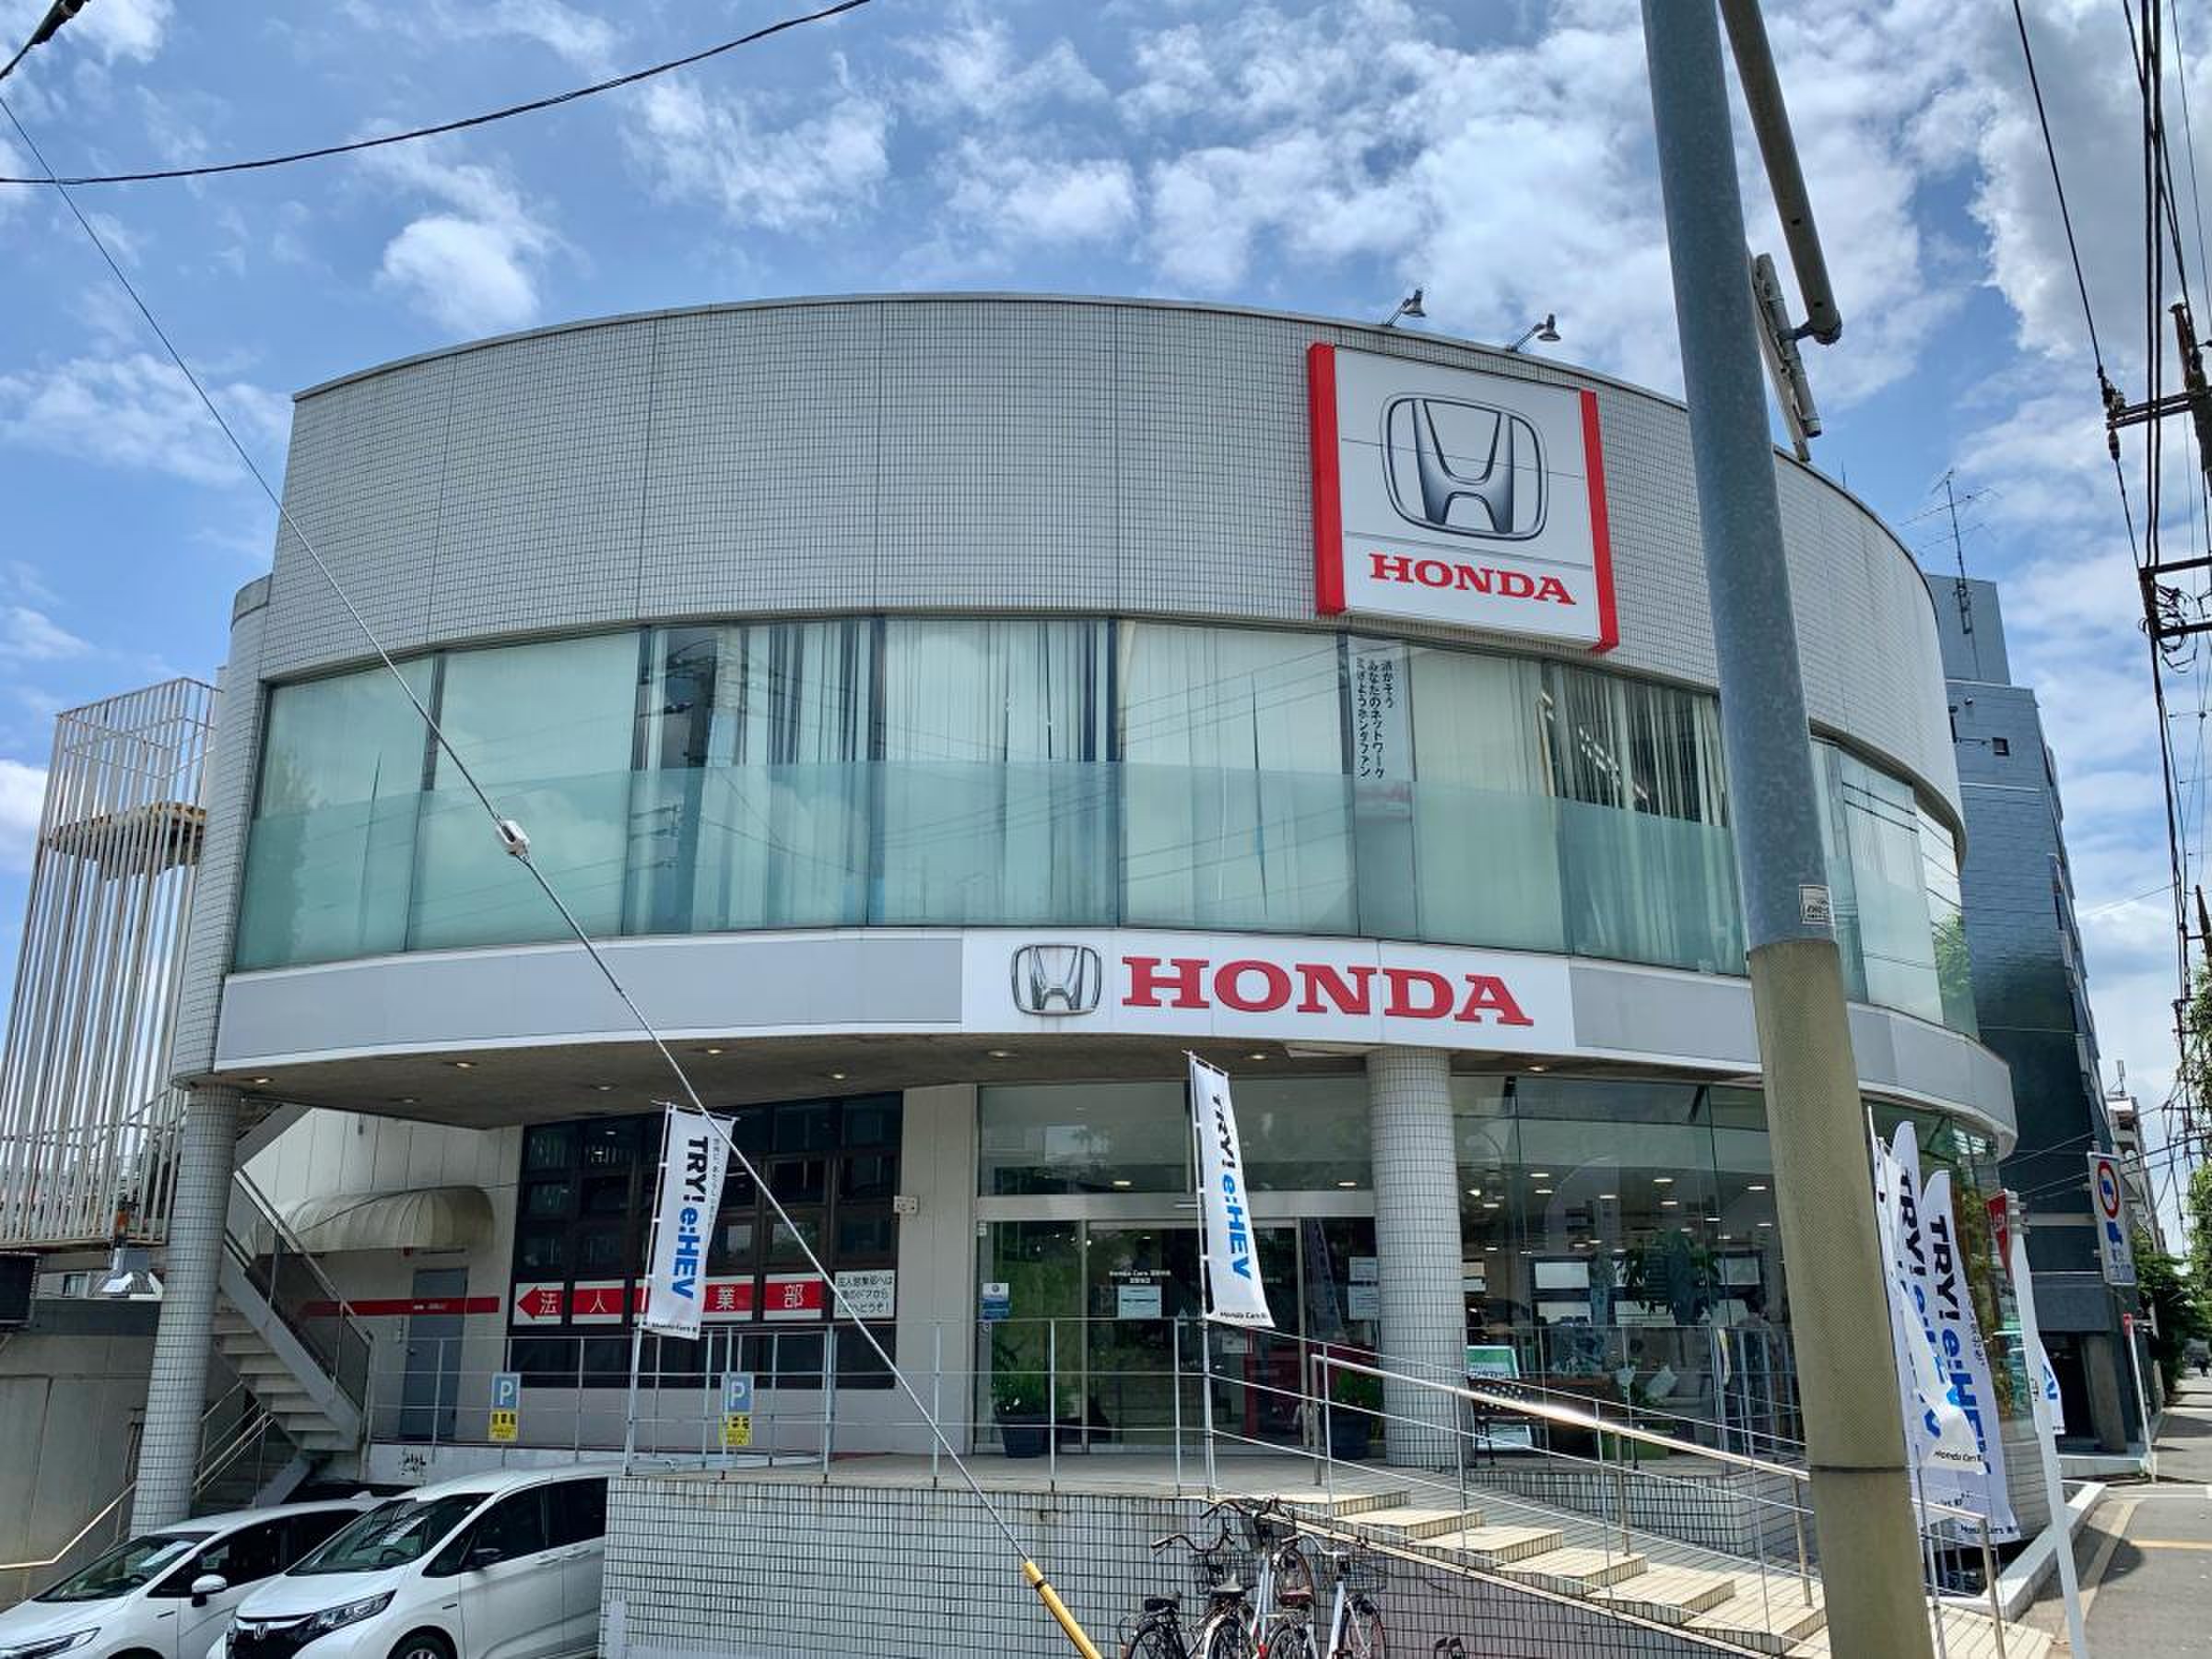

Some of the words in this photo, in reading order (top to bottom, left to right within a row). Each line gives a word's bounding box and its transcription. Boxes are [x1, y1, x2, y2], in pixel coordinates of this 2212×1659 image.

[1369, 553, 1576, 605] HONDA
[1122, 957, 1534, 1026] HONDA
[1213, 1094, 1236, 1169] TRY!
[683, 1136, 708, 1203] TRY!
[672, 1206, 700, 1300] e:HEV
[1223, 1173, 1252, 1280] e:HEV
[1900, 1171, 1926, 1277] TRY!
[1930, 1215, 1960, 1321] TRY!
[500, 1381, 512, 1406] P
[731, 1381, 745, 1407] P
